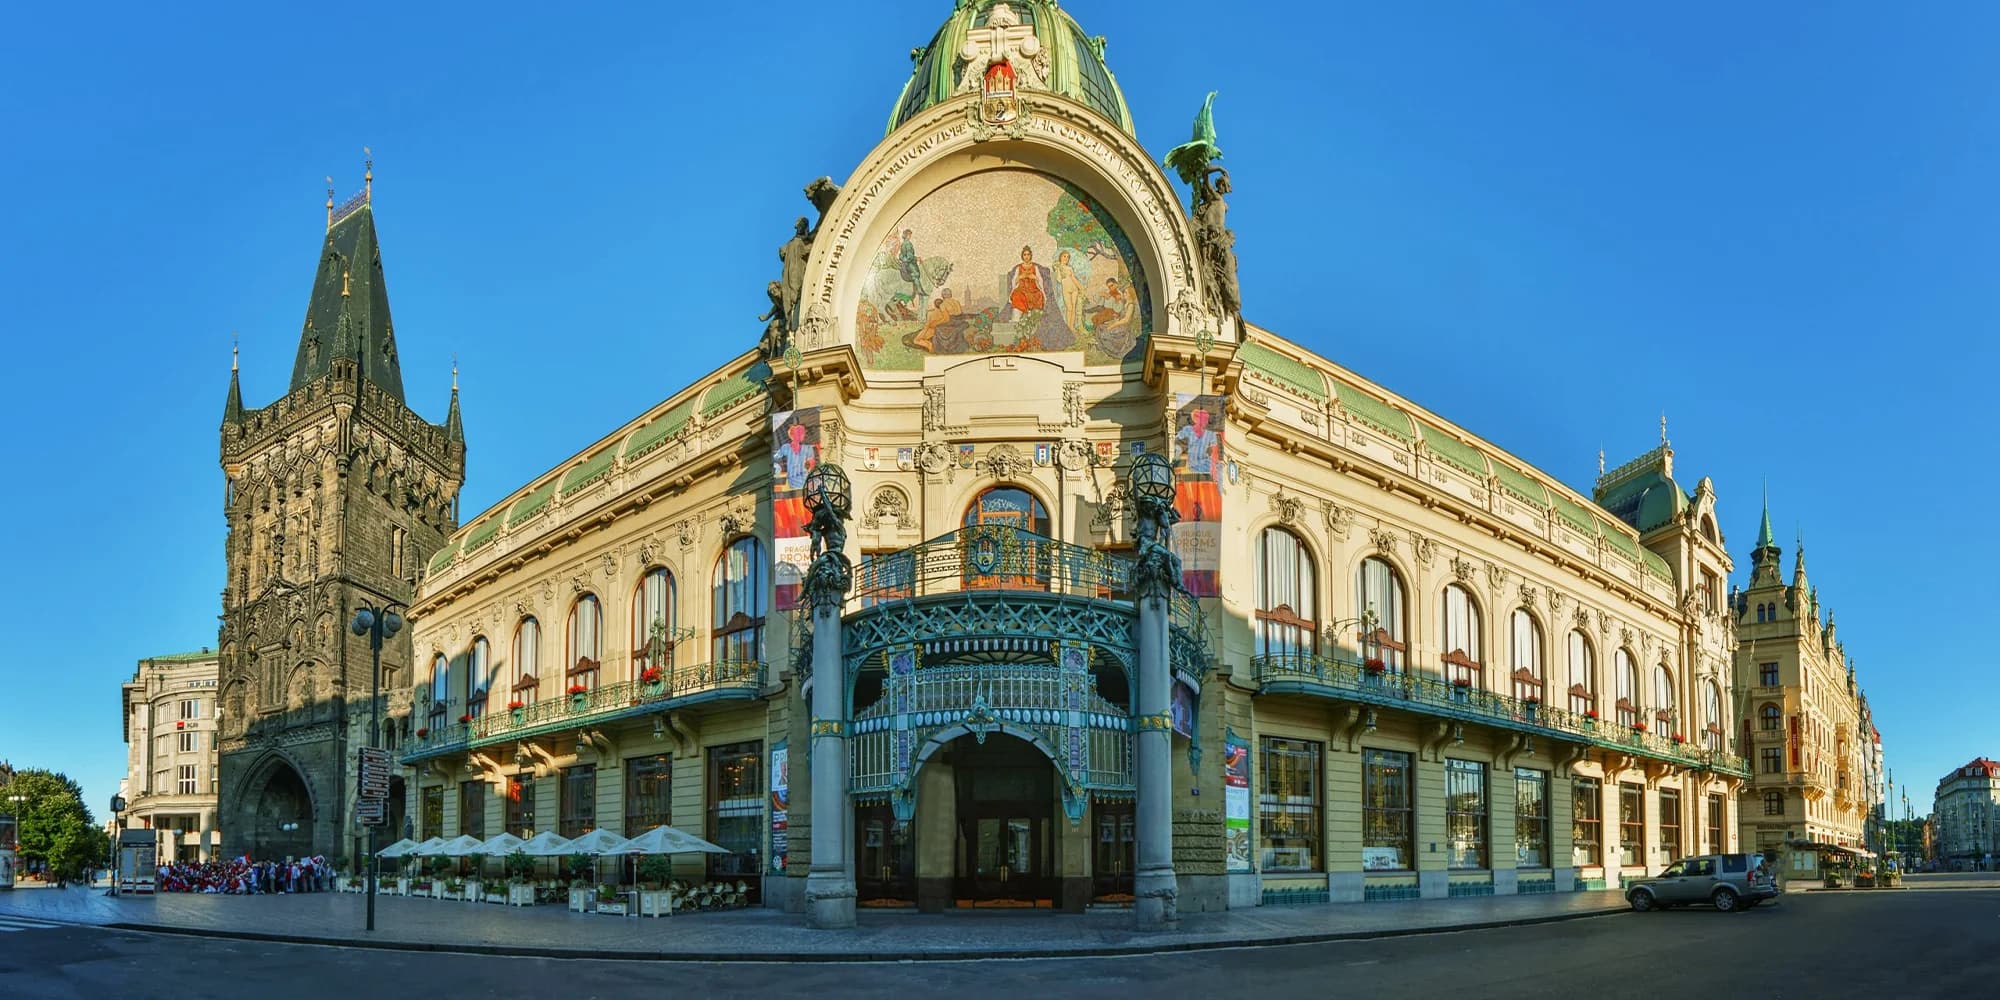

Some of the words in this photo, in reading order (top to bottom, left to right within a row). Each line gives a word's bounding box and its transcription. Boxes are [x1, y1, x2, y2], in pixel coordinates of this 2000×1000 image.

[1176, 537, 1217, 547] PROMS
[785, 544, 810, 553] PRAGU
[780, 552, 811, 561] PROM
